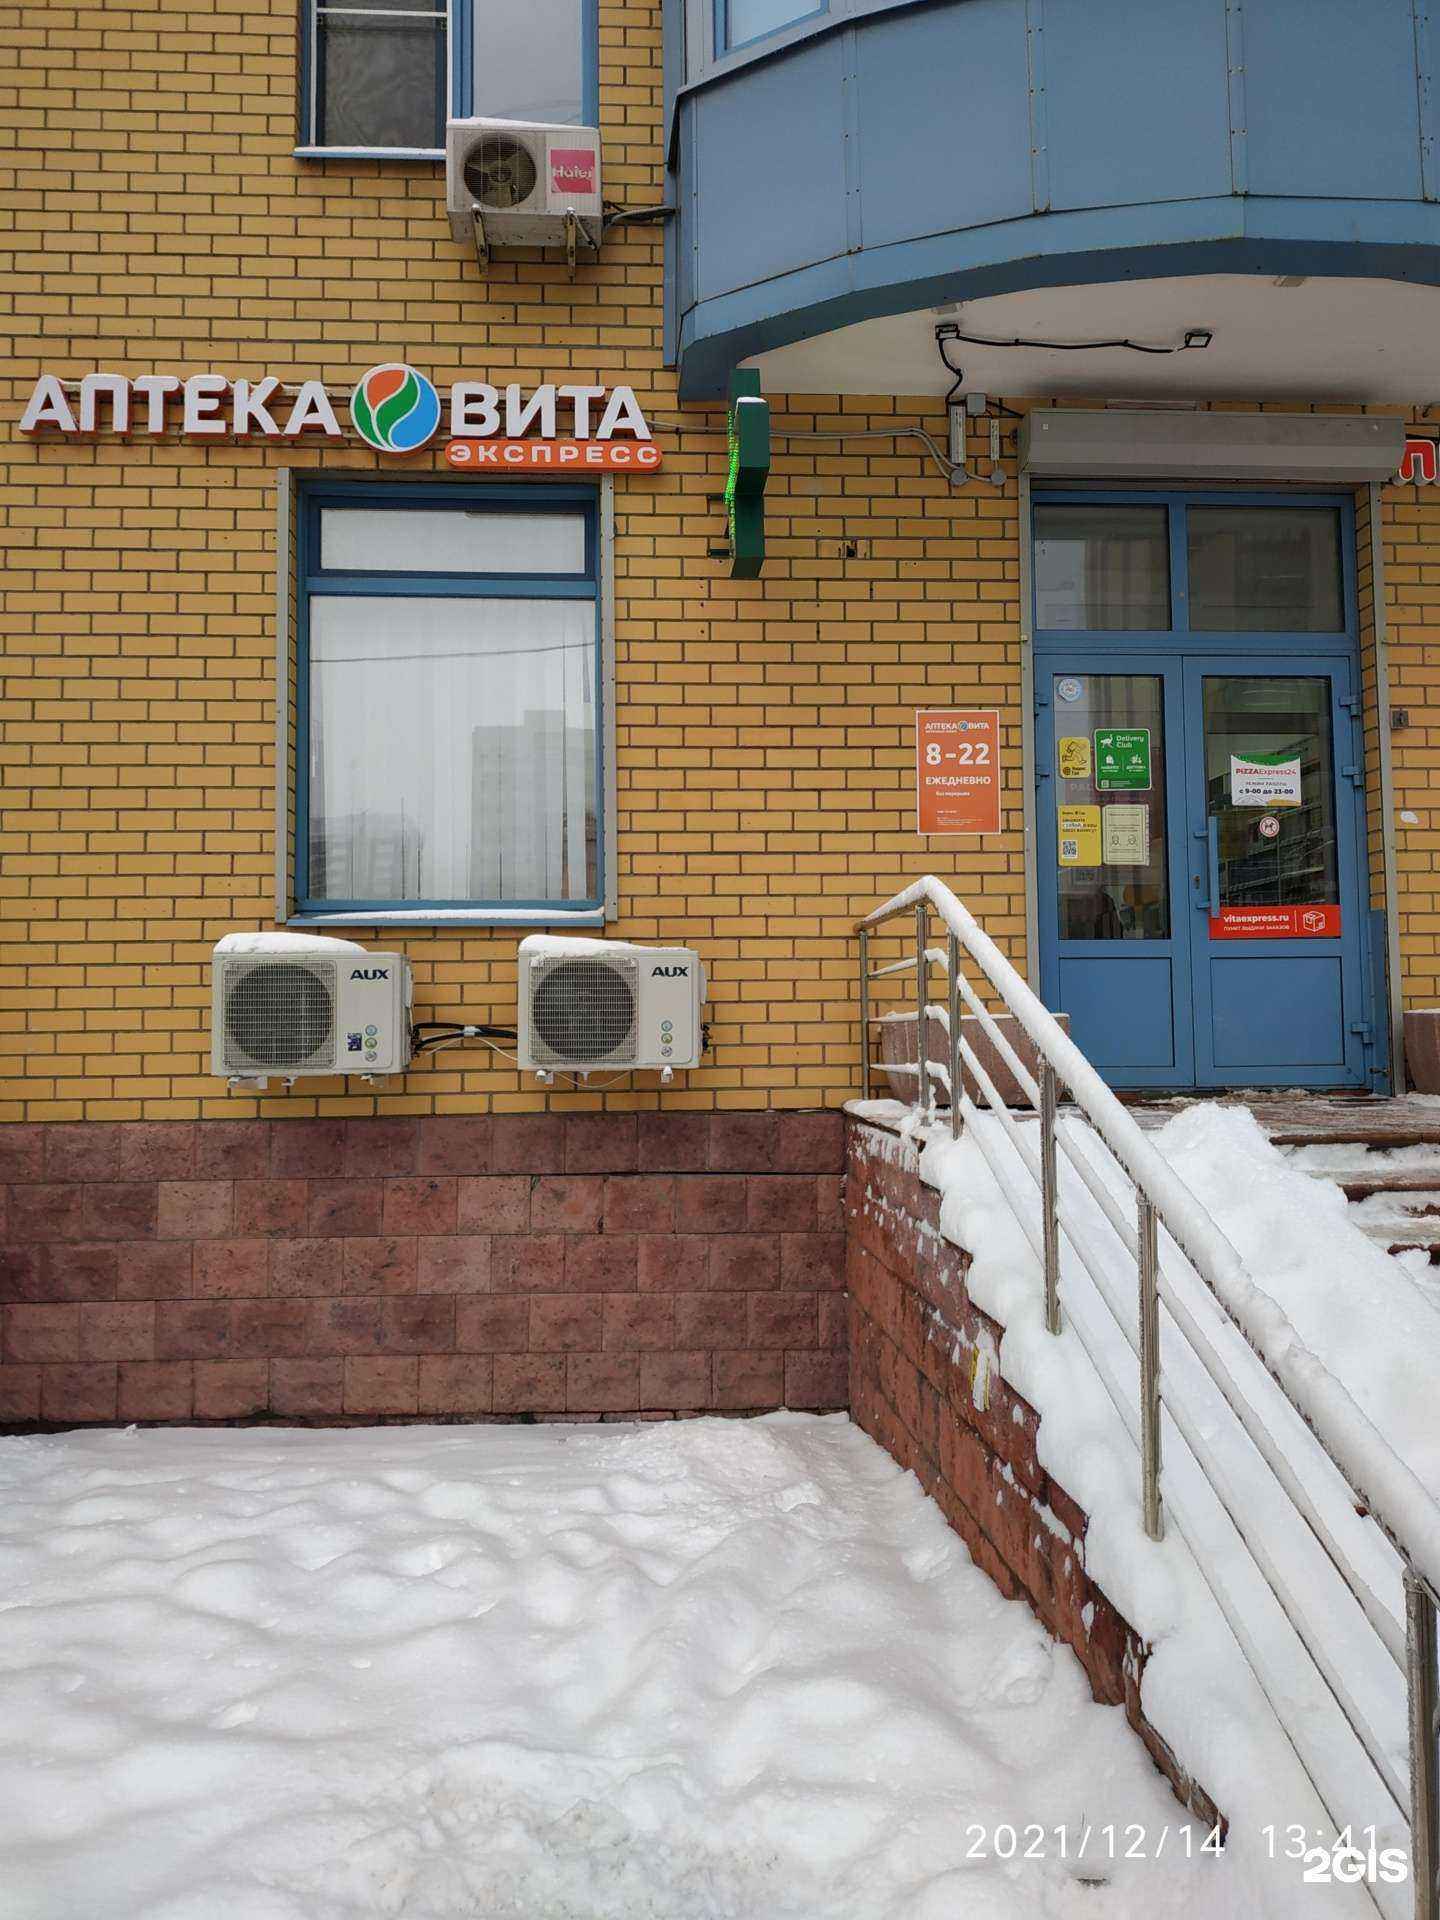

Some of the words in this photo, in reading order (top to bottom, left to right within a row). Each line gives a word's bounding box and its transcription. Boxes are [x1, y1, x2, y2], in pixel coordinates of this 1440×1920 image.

[19, 374, 343, 437] АПТЕКА
[449, 382, 652, 440] ВИТА
[449, 444, 660, 467] ЭКСПРЕСС
[1399, 439, 1440, 481] П
[924, 721, 958, 731] АПТЕКА
[968, 721, 990, 730] ВИТА
[1116, 735, 1144, 743] Delivery
[925, 775, 992, 786] ЕЖЕДНЕВНО
[1223, 914, 1290, 924] vitaexpress.ru
[349, 968, 390, 981] AUX
[651, 965, 689, 978] AUX
